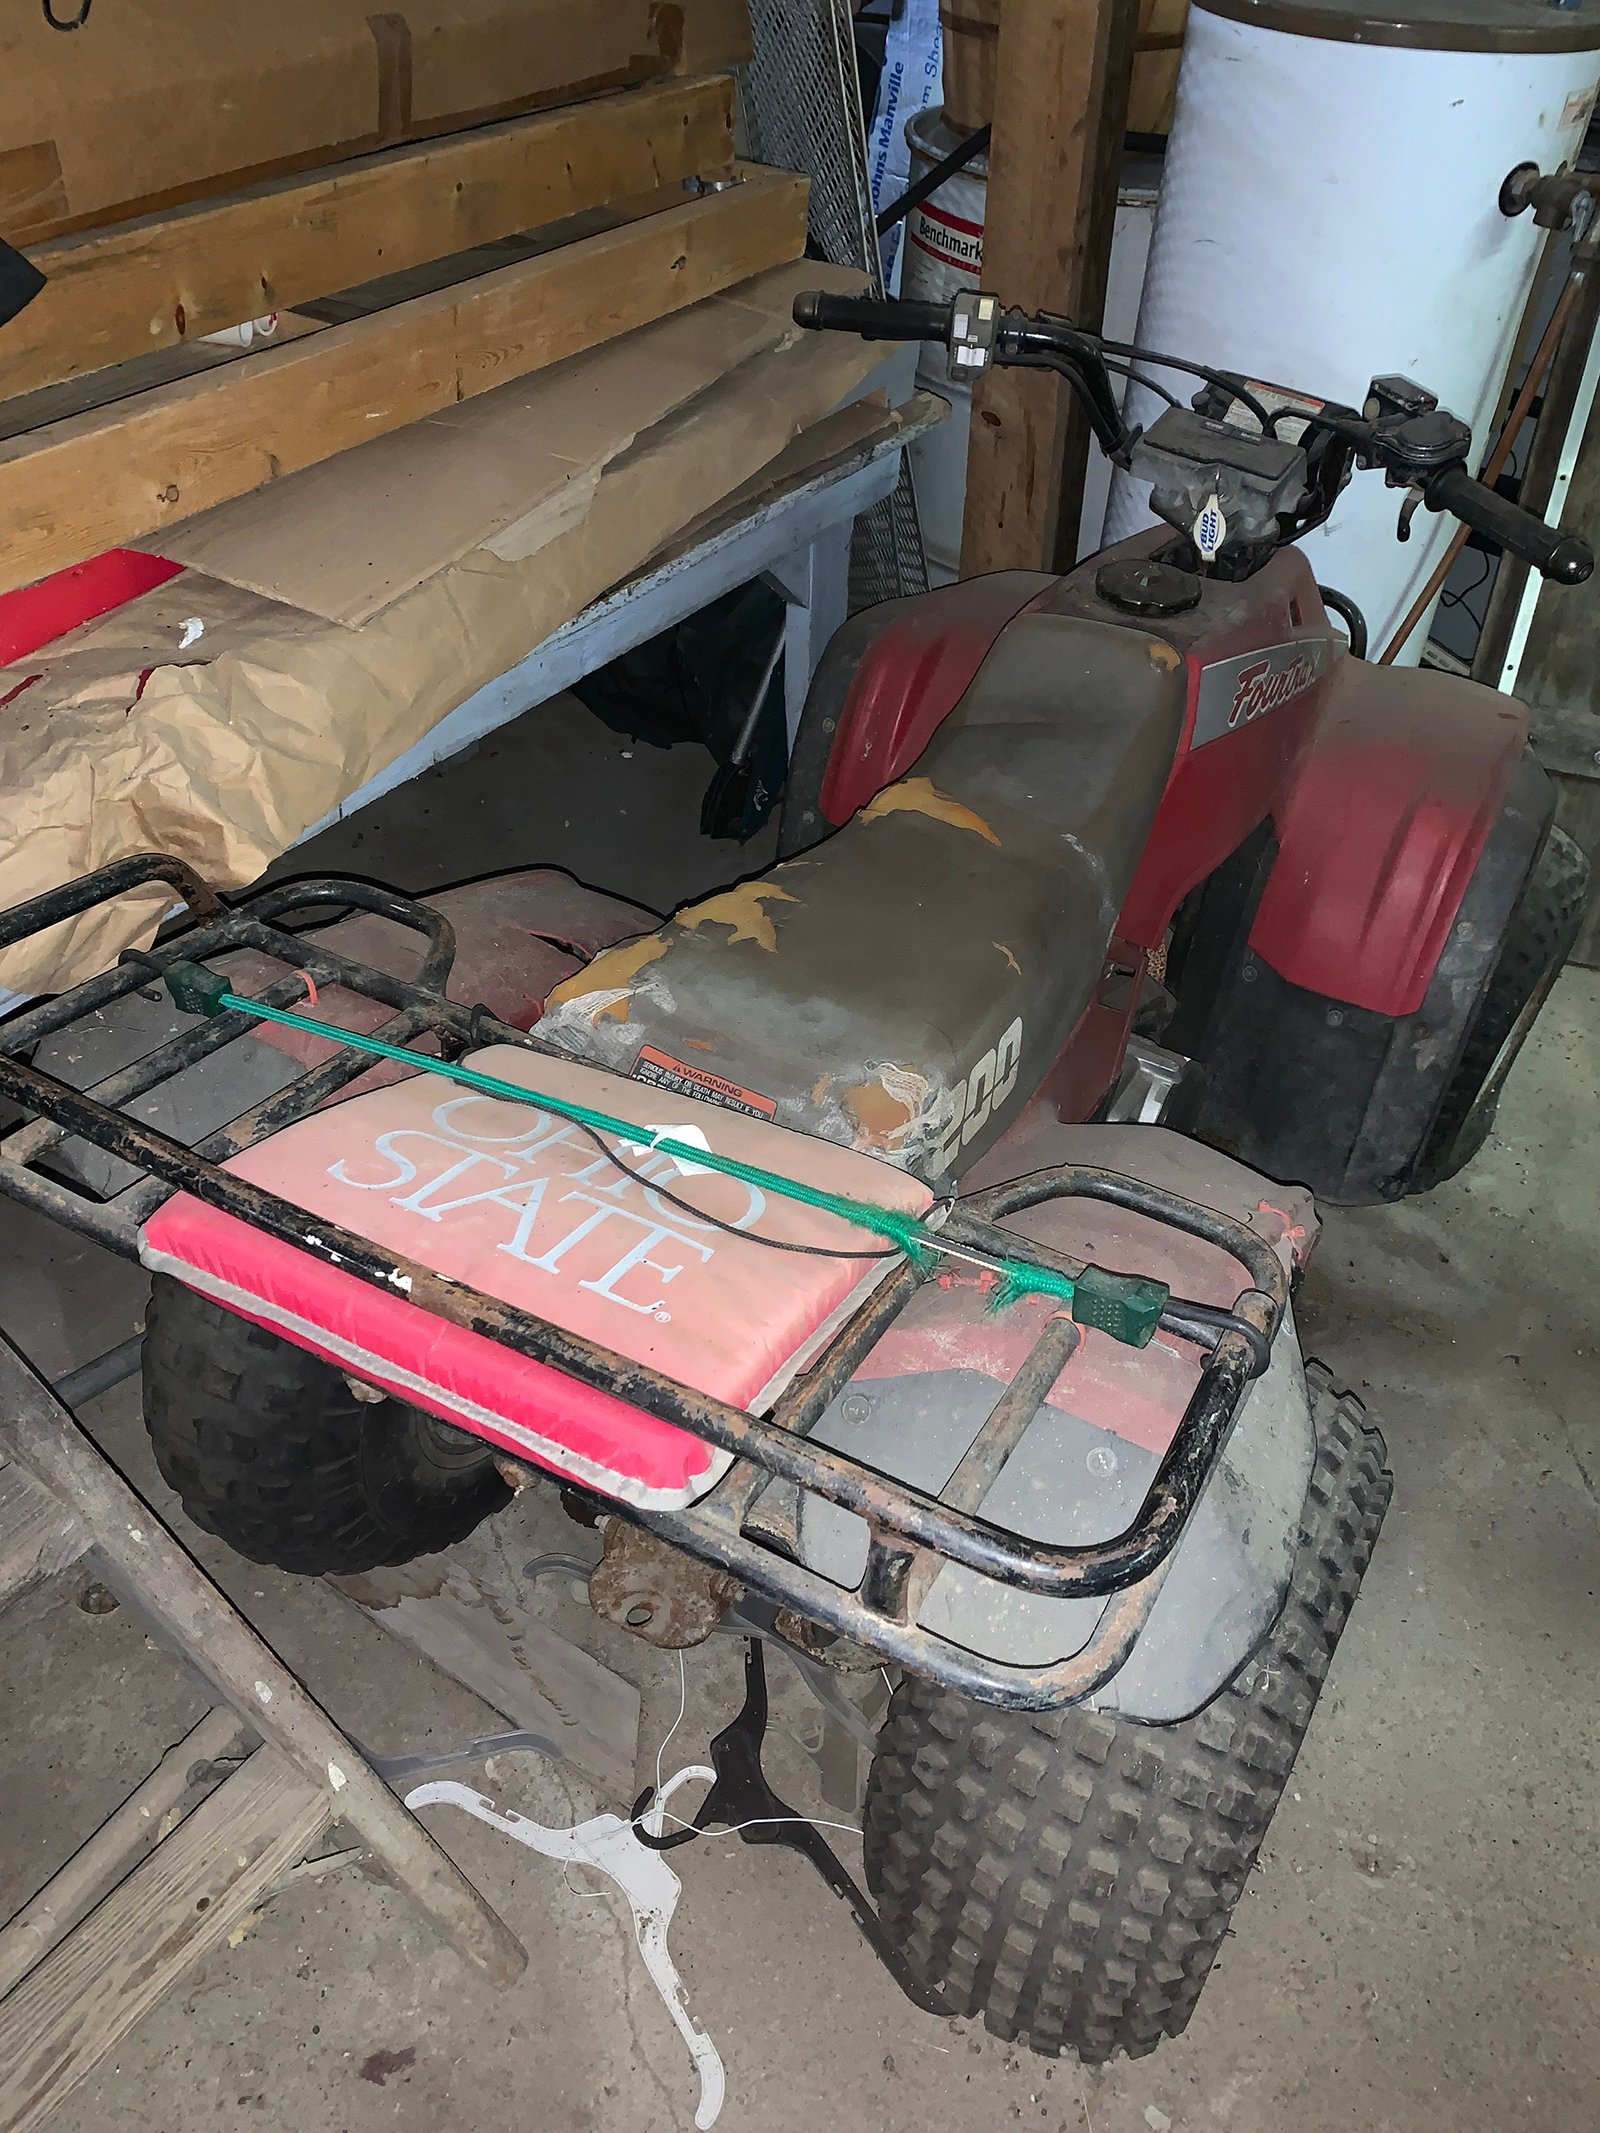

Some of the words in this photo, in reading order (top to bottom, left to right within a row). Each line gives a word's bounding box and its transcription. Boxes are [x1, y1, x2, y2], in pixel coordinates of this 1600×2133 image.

[878, 61, 905, 149] Manville
[1200, 512, 1210, 545] BUD
[1207, 508, 1218, 551] LIGHT
[639, 1067, 658, 1080] IGNORE
[658, 1075, 672, 1087] ANY
[671, 1081, 681, 1090] OF
[680, 1086, 692, 1096] THE
[642, 1060, 664, 1076] SERIOUS
[664, 1071, 685, 1084] INJURY
[683, 1079, 693, 1089] OR
[692, 1083, 711, 1096] DEATH
[711, 1091, 725, 1102] MAY
[724, 1095, 744, 1110] RESULT
[752, 1108, 765, 1119] YOU
[683, 1067, 743, 1098] WARNING
[431, 1095, 767, 1232] OHIO
[325, 1129, 716, 1316] STATE
